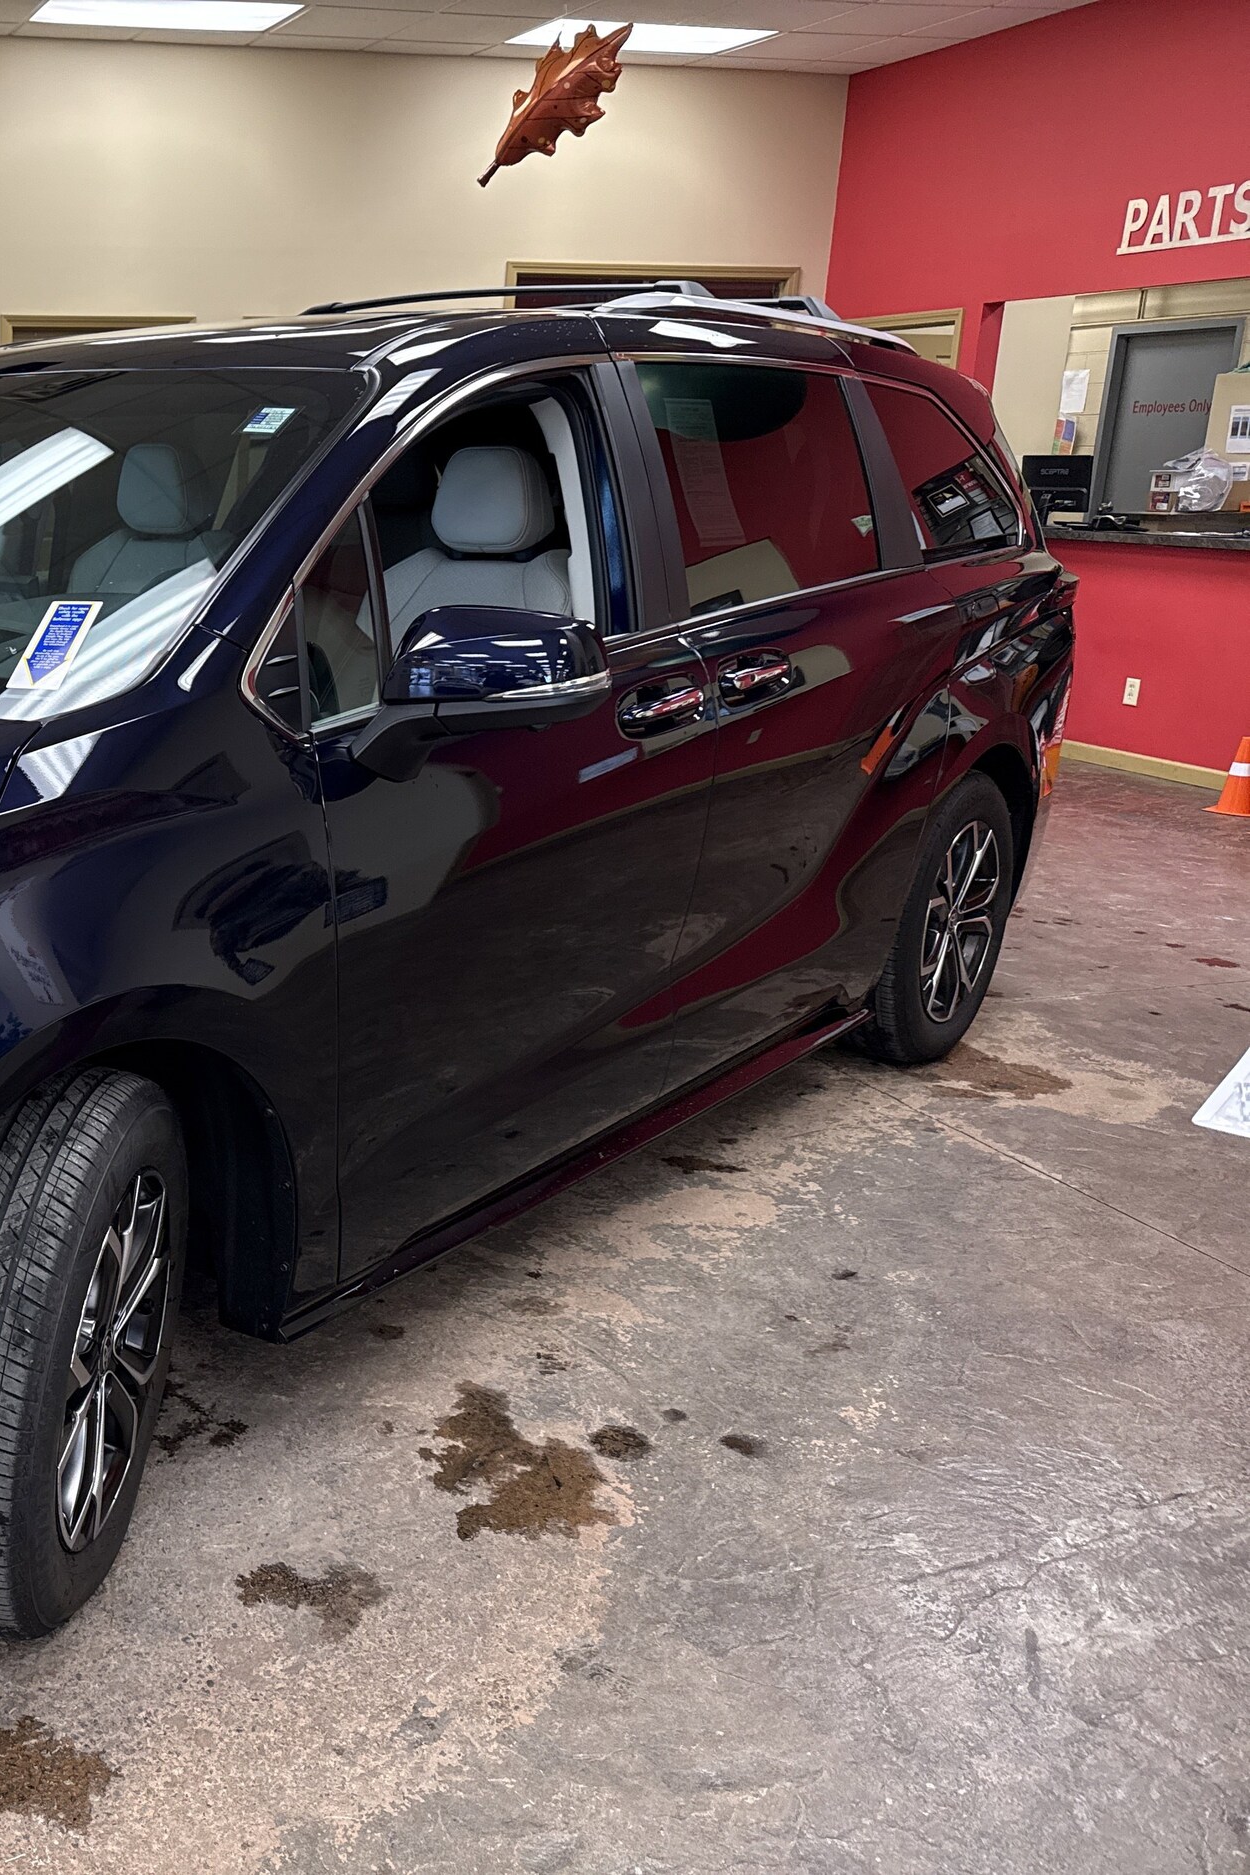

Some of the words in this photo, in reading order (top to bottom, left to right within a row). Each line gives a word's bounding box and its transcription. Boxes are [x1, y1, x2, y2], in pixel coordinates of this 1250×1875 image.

[1119, 180, 1250, 249] PARTS
[1132, 400, 1186, 416] Employees
[1188, 398, 1212, 415] Only
